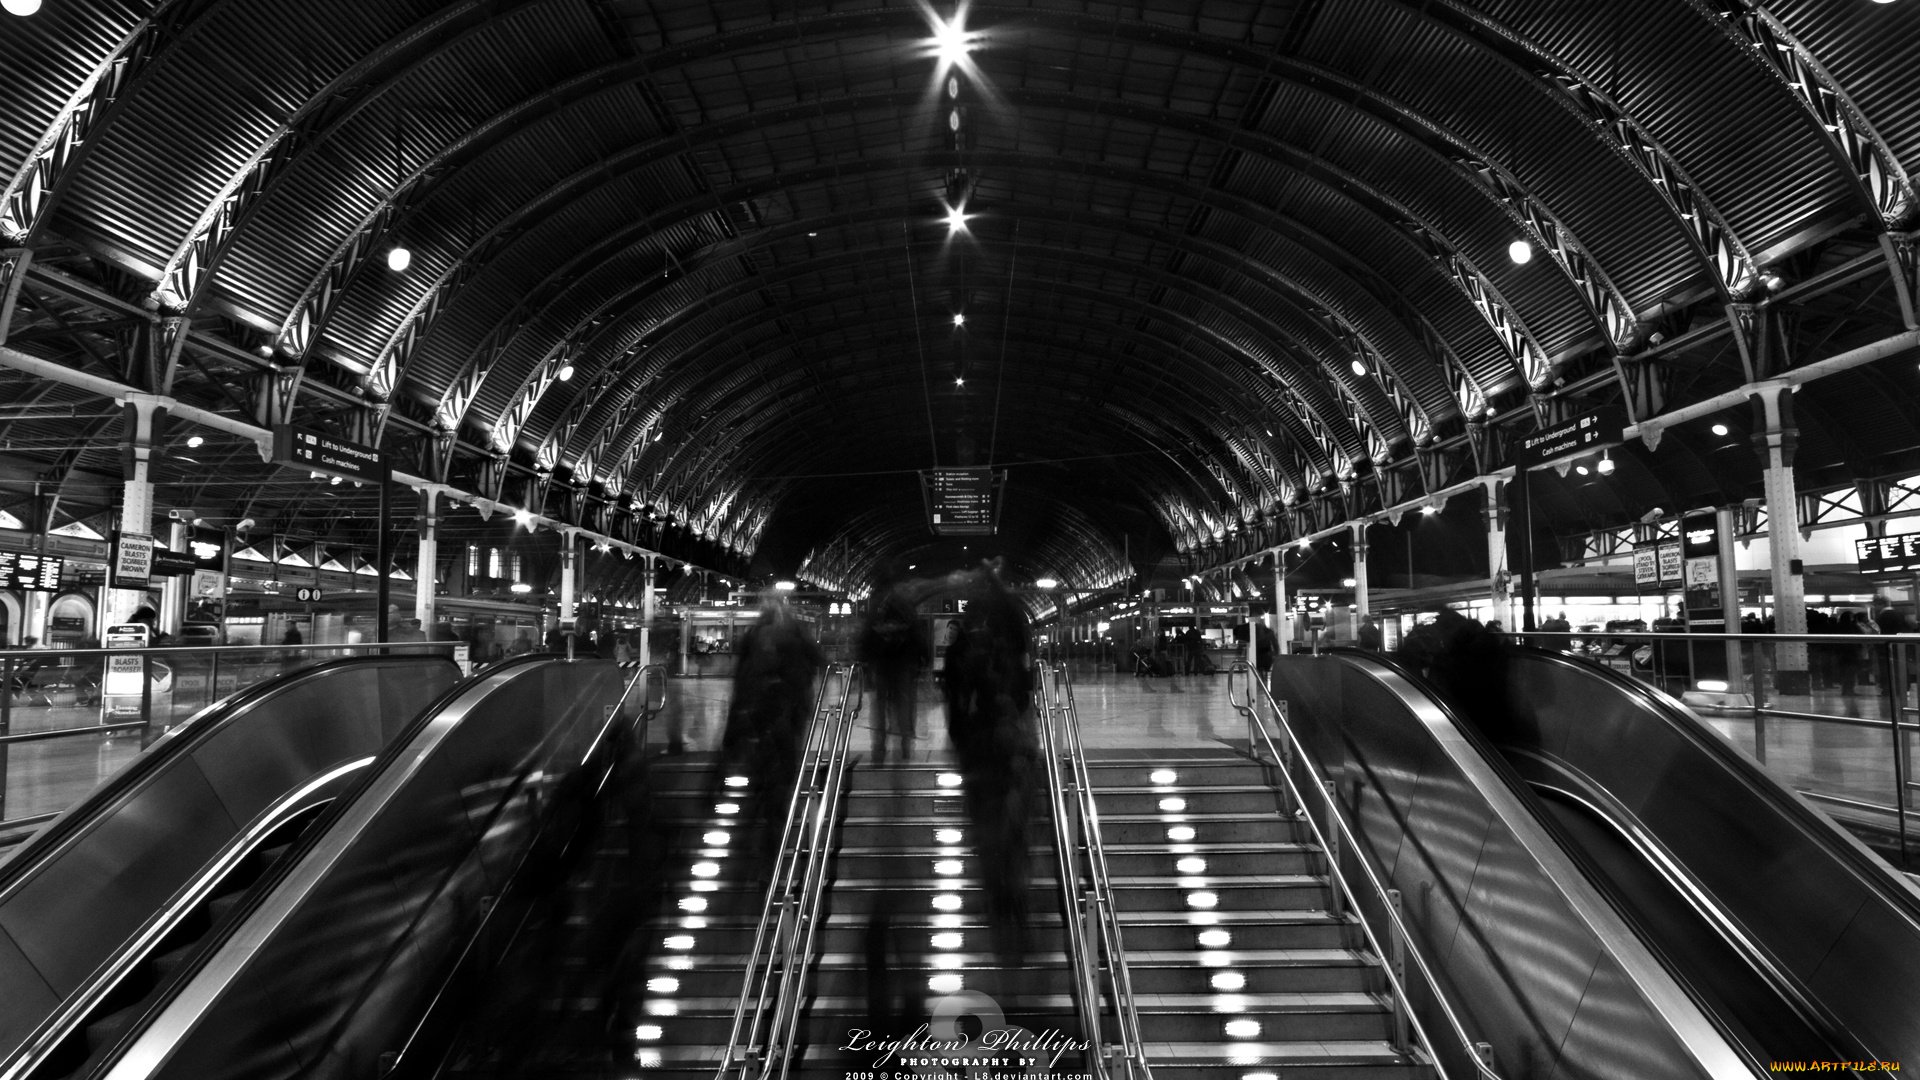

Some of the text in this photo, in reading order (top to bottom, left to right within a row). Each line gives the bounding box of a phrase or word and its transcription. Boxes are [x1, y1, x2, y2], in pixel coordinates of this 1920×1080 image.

[1531, 437, 1540, 446] Lift
[1545, 423, 1577, 441] Underground
[322, 440, 372, 460] Lift to Underground
[1542, 440, 1578, 456] Cash machines
[322, 454, 360, 471] Cash machines
[120, 542, 151, 552] CAMERON
[124, 550, 146, 559] BLASTS
[945, 604, 950, 612] 5
